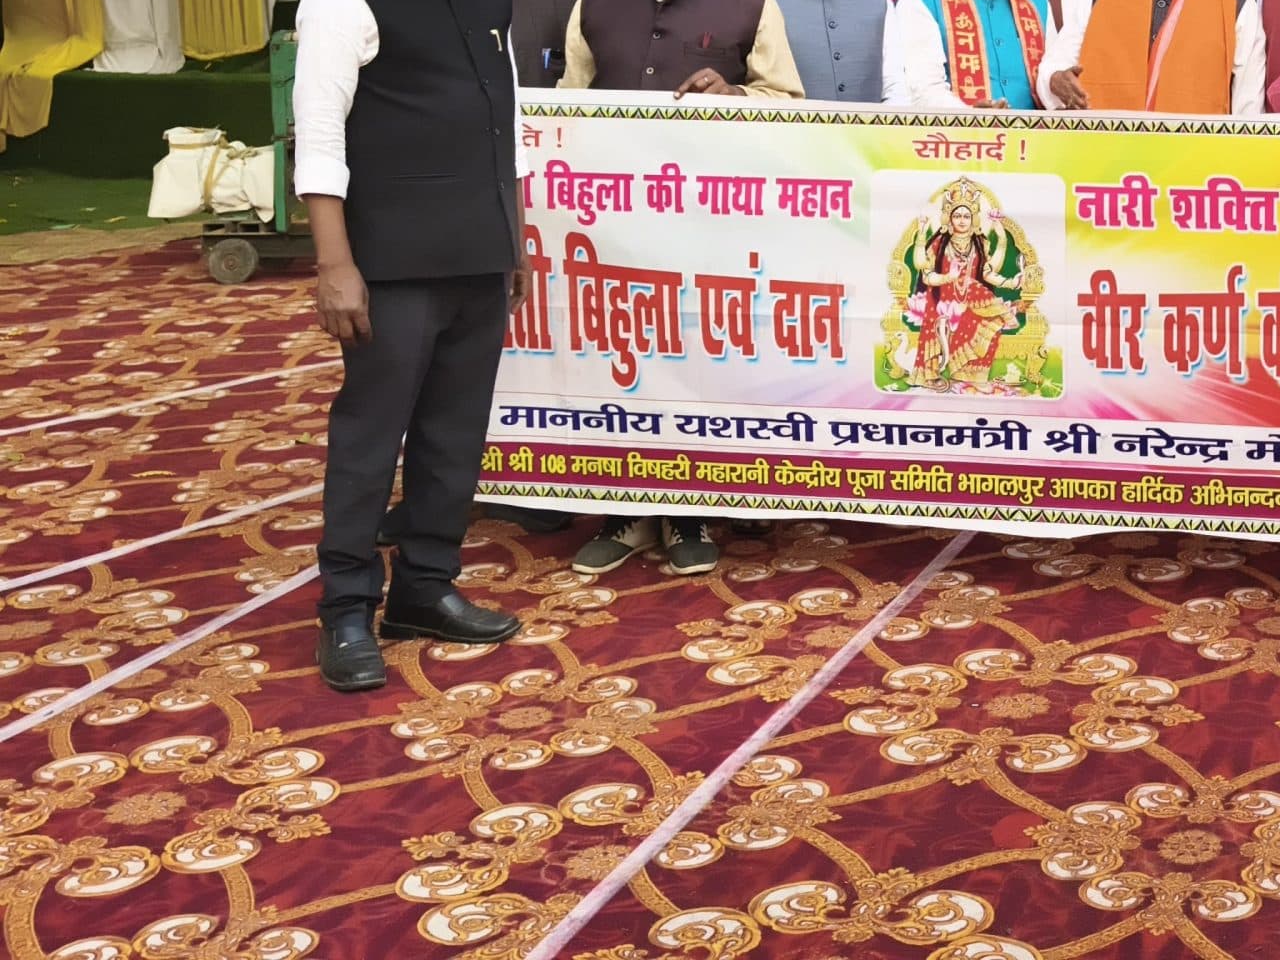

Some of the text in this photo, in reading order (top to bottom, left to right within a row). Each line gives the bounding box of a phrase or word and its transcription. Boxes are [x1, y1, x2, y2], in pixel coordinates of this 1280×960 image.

[912, 132, 1007, 161] सौहार्द
[544, 160, 634, 225] बिहुला
[643, 163, 687, 213] की
[696, 175, 766, 216] गाथा
[776, 178, 853, 218] महान
[1075, 175, 1158, 228] नारी
[1170, 177, 1279, 231] शक्ति
[563, 231, 683, 387] बिहुला
[695, 252, 759, 356] एवं
[769, 280, 845, 358] दान
[1078, 270, 1146, 370] वीर
[1159, 265, 1245, 376] कर्ण
[499, 403, 663, 435] माननीय
[674, 411, 817, 442] यशस्वी
[829, 418, 1032, 451] प्रधानमंत्री
[1043, 423, 1101, 454] श्री
[1112, 427, 1233, 463] नरेन्द्र
[508, 446, 534, 473] श्री
[540, 453, 567, 474] 108
[571, 455, 623, 478] मनषा
[627, 451, 692, 481] विषहरी
[696, 457, 770, 485] महारानी
[774, 459, 842, 489] केन्द्रीय
[846, 467, 885, 497] पूजा
[890, 464, 953, 493] समिति
[958, 471, 1046, 504] भागलपुर
[1050, 477, 1117, 501] आपका
[1121, 475, 1185, 503] हार्दिक
